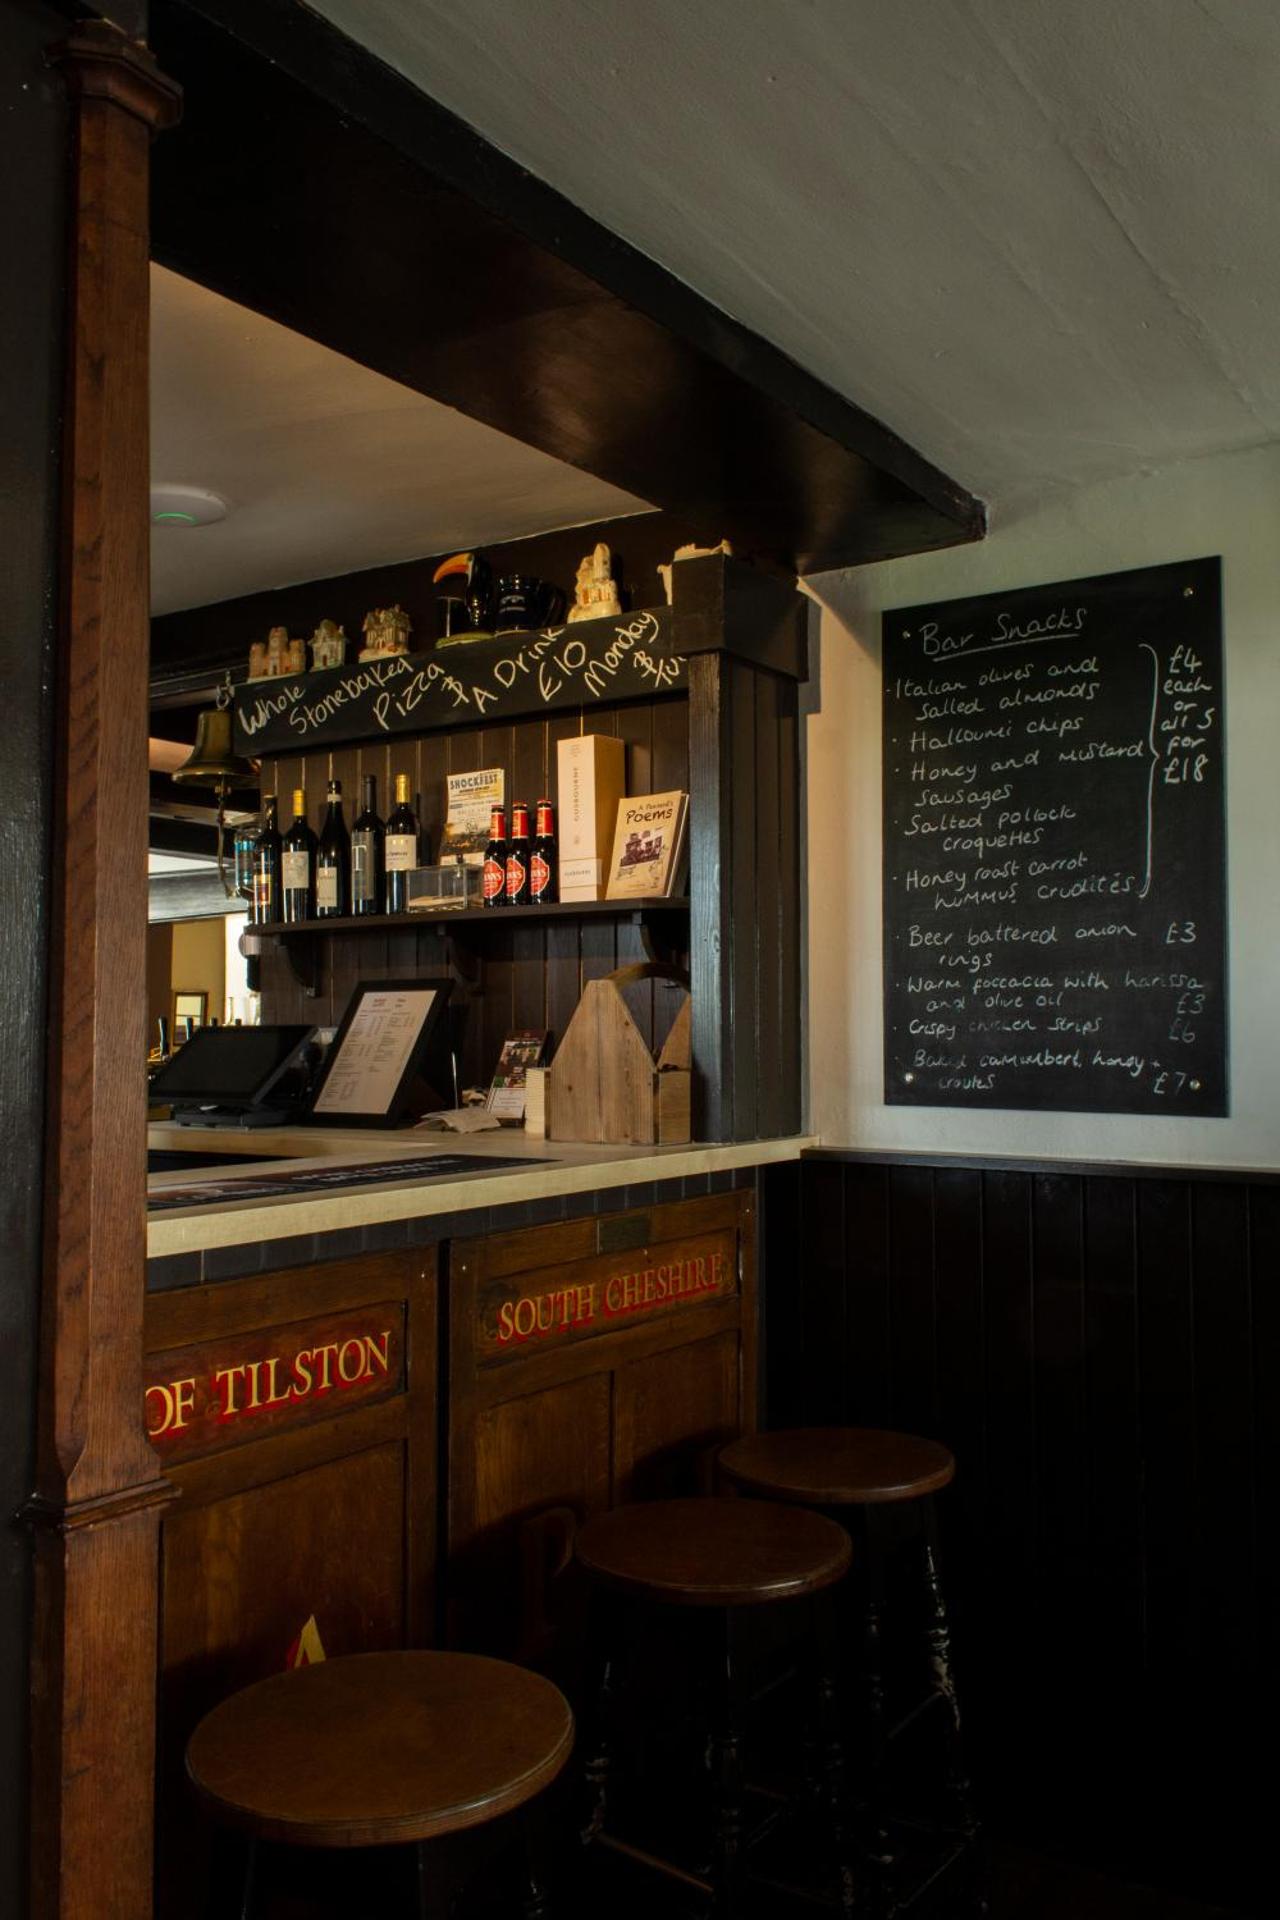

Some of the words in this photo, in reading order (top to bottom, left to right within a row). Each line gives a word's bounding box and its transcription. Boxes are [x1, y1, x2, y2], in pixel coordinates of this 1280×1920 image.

[919, 622, 974, 656] Bar
[990, 607, 1087, 642] Snacks
[1169, 644, 1202, 674] £4
[238, 685, 306, 736] Whole
[289, 656, 414, 735] Stonebaked
[373, 662, 446, 731] Pizza
[472, 686, 499, 714] A
[494, 627, 567, 689] Drink
[584, 611, 660, 698] Monday
[655, 656, 688, 689] Tu
[895, 678, 968, 698] Italian
[979, 664, 1034, 686] olives
[1047, 656, 1099, 676] and
[1163, 676, 1213, 694] each
[1000, 682, 1100, 709] almonds
[1174, 700, 1198, 713] or
[911, 720, 1012, 752] Halloumi
[1026, 714, 1083, 738] chips
[1161, 713, 1188, 732] all
[1197, 707, 1215, 731] 5
[1167, 735, 1206, 756] for
[911, 760, 977, 783] Honey
[991, 750, 1039, 772] and
[1059, 740, 1143, 762] mustard
[1163, 754, 1208, 784] £18
[626, 808, 673, 824] Poems
[904, 811, 983, 835] Salted
[999, 804, 1076, 829] pollock
[942, 827, 1044, 858] croquettes
[906, 870, 966, 892] Honey
[974, 861, 1019, 881] roast
[1027, 851, 1088, 876] carrot
[909, 925, 953, 947] Beer
[967, 928, 1058, 946] battered
[1074, 922, 1137, 938] onion
[1166, 922, 1197, 944] £3
[939, 952, 992, 974] rings
[907, 976, 961, 993] Warm
[1064, 972, 1110, 990] with
[926, 996, 967, 1014] and
[985, 995, 1024, 1008] olive
[1036, 992, 1063, 1007] oil
[1177, 993, 1206, 1015] £3
[909, 1018, 956, 1040] Crispy
[969, 1019, 1037, 1034] chien
[913, 1049, 968, 1070] Bad
[498, 1283, 596, 1341] SOUTH
[606, 1253, 723, 1313] CHESHIRE
[145, 1379, 196, 1436] OF
[216, 1331, 391, 1415] TILSTON
